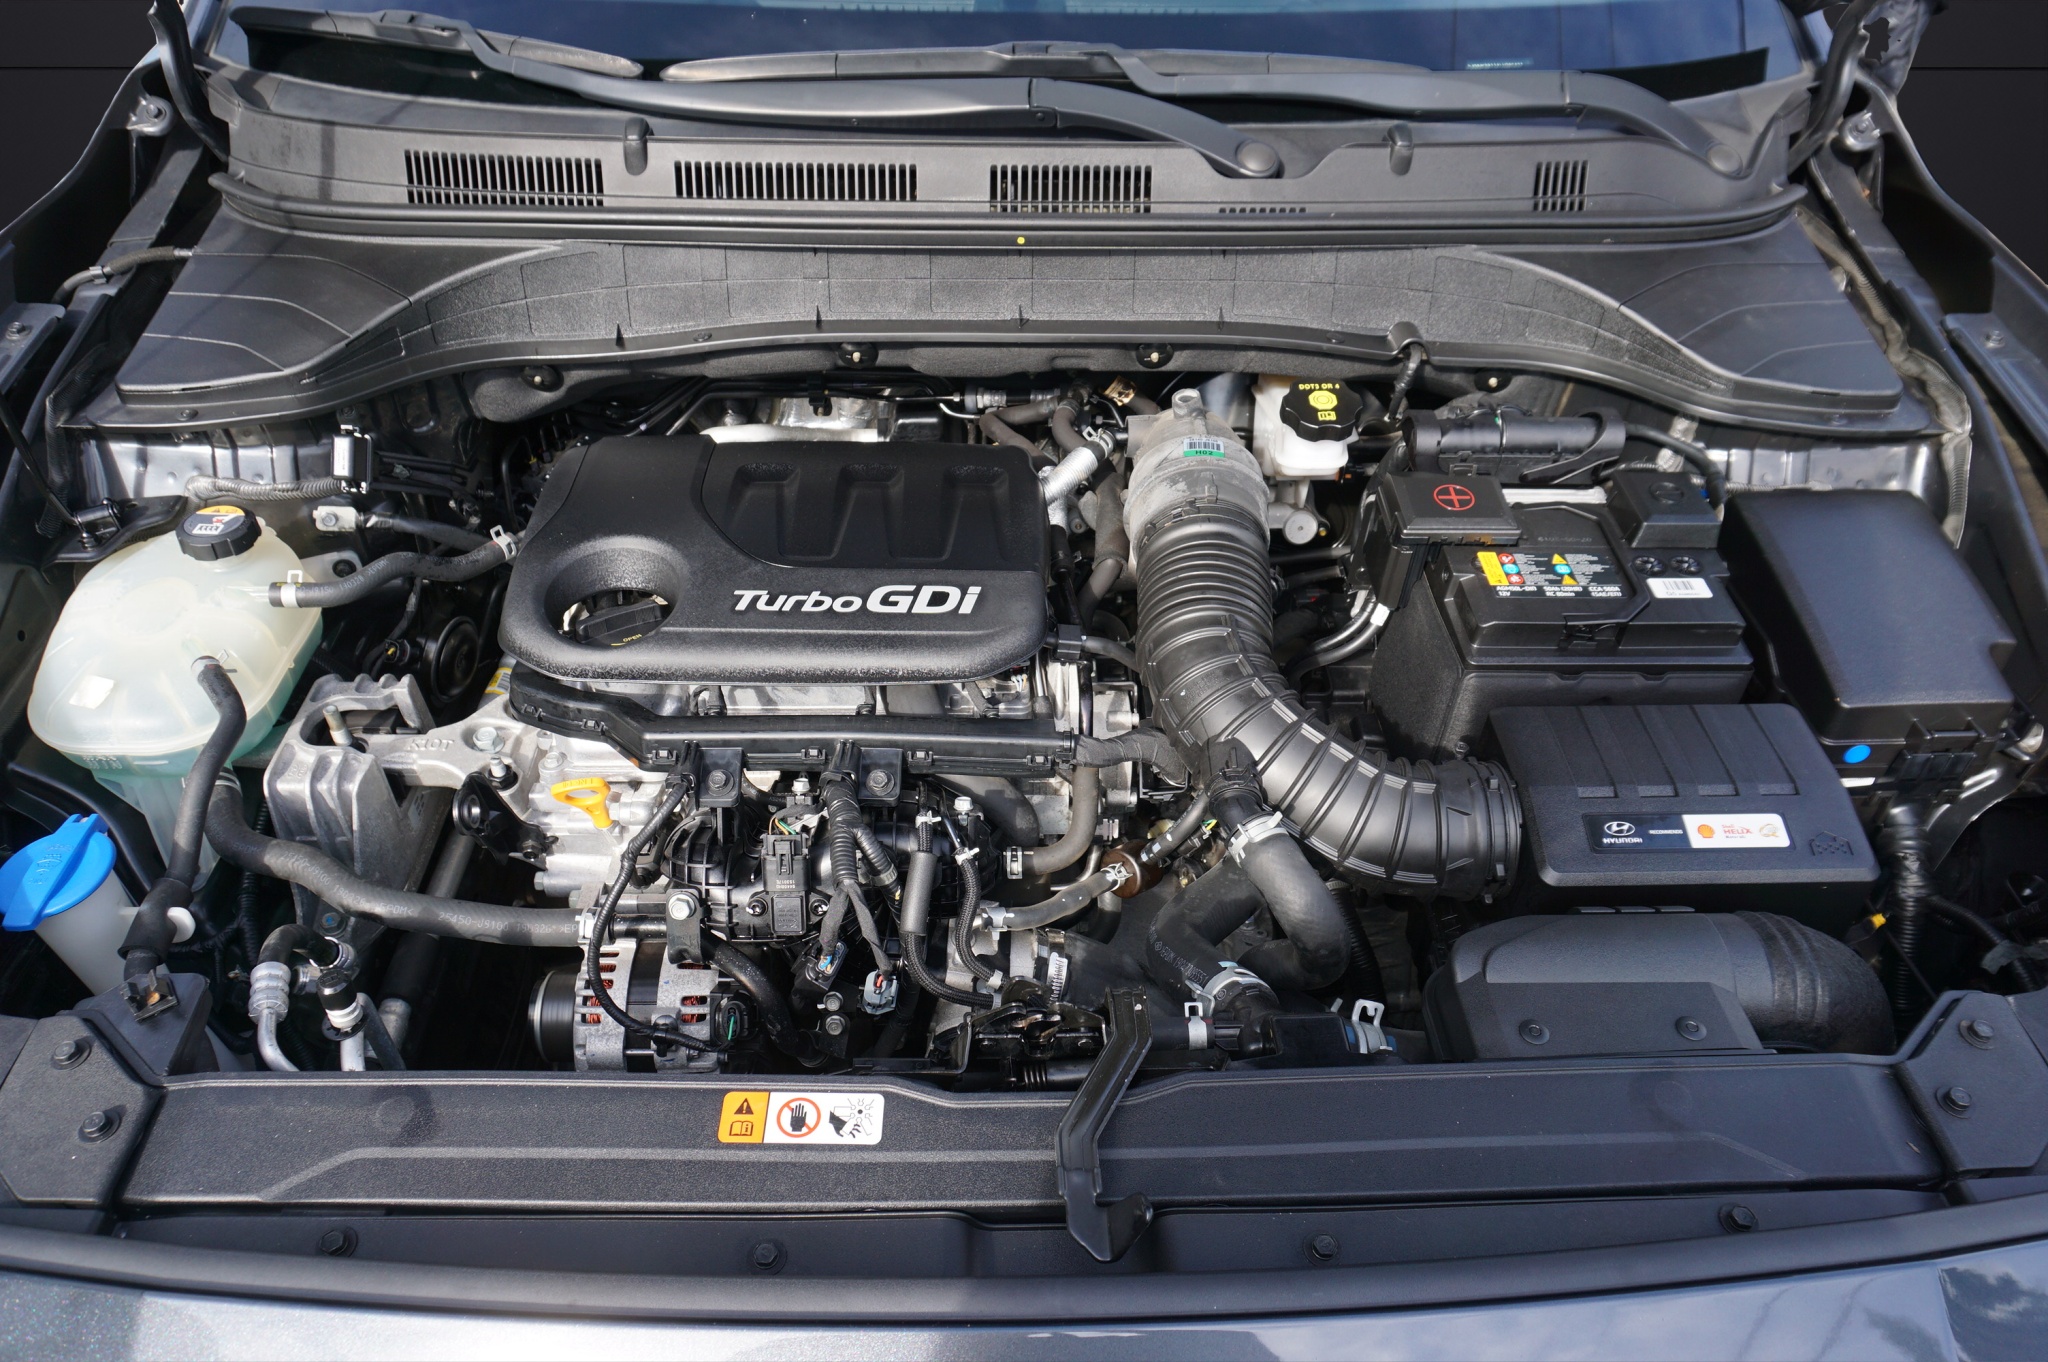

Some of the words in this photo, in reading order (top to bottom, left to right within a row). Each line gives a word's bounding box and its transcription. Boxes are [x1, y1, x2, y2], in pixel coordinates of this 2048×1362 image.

[733, 590, 863, 613] Turbo
[866, 584, 982, 614] GDi
[622, 633, 643, 643] OPEN
[437, 911, 509, 931] 25450-J9100
